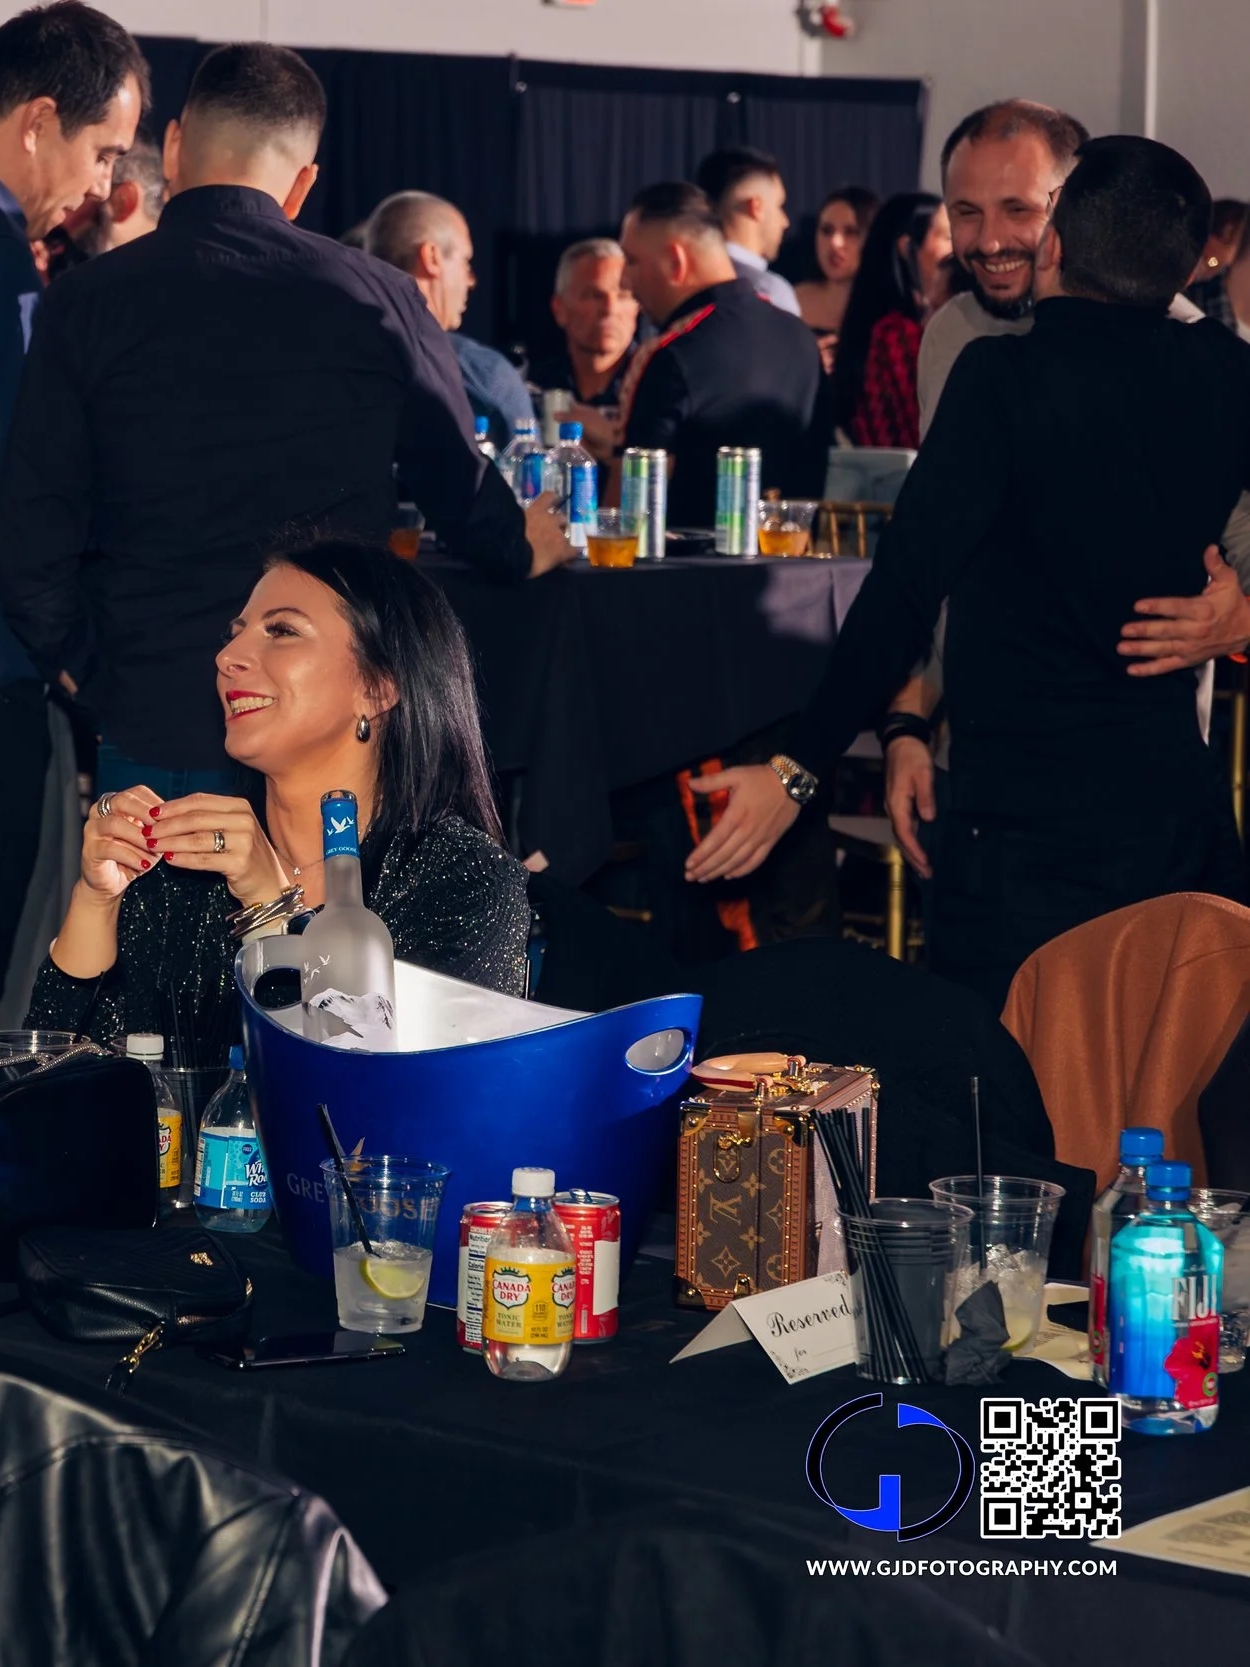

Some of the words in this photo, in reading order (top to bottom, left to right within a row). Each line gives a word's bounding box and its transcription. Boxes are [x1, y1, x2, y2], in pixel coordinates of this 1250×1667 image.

[286, 1172, 326, 1203] GRE
[493, 1279, 532, 1293] CANADA
[499, 1291, 520, 1302] DRY
[1171, 1274, 1218, 1321] FIJI
[497, 1312, 519, 1321] TONIC
[767, 1294, 851, 1337] Reserved
[495, 1319, 522, 1329] WATER
[794, 1347, 807, 1362] for
